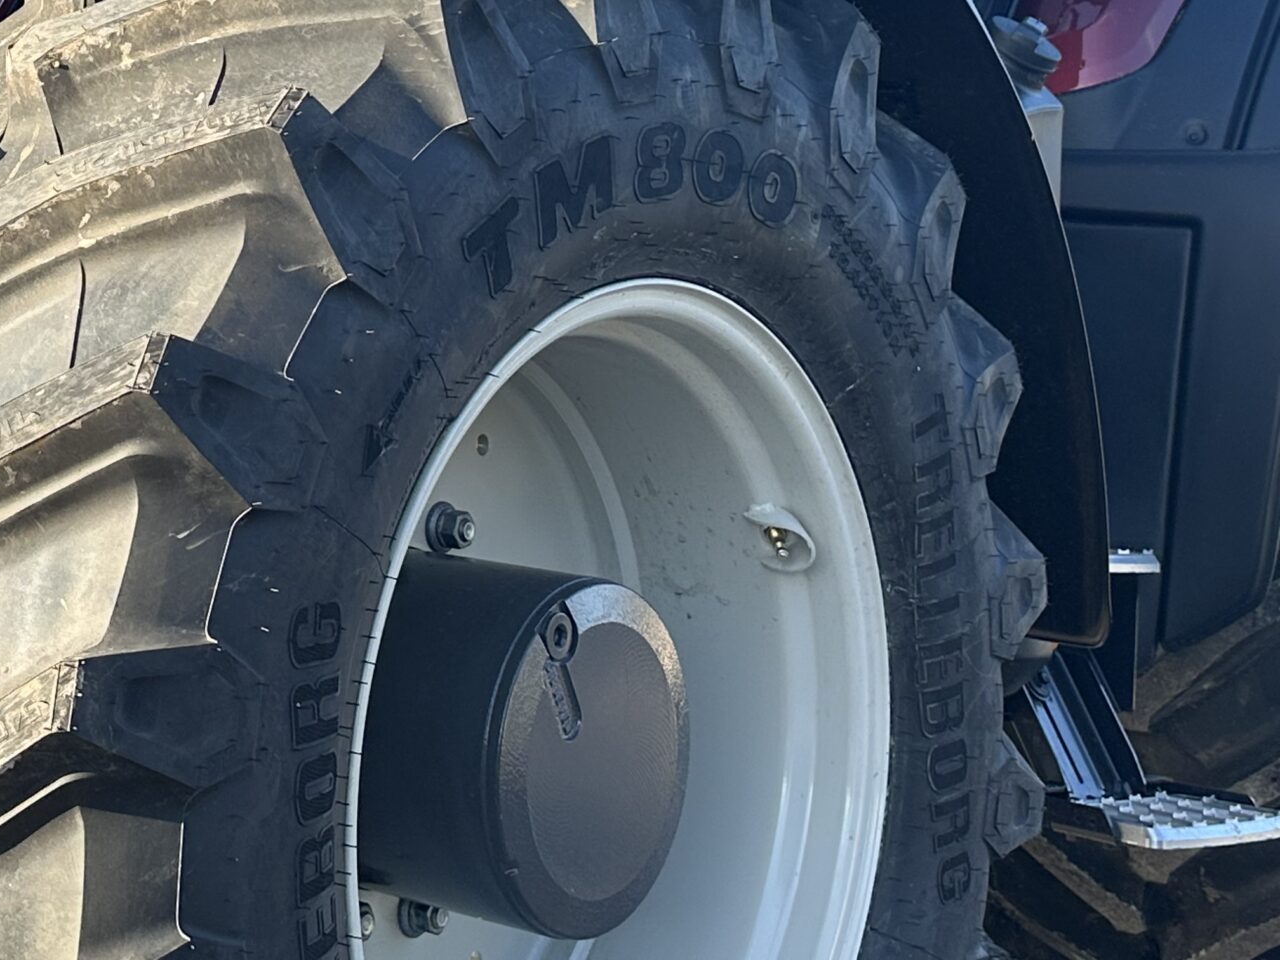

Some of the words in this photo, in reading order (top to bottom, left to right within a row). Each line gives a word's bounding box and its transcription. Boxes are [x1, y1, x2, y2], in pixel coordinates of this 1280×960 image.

[461, 134, 619, 299] TM
[633, 122, 798, 228] 800
[913, 393, 971, 906] TRELLEBORG
